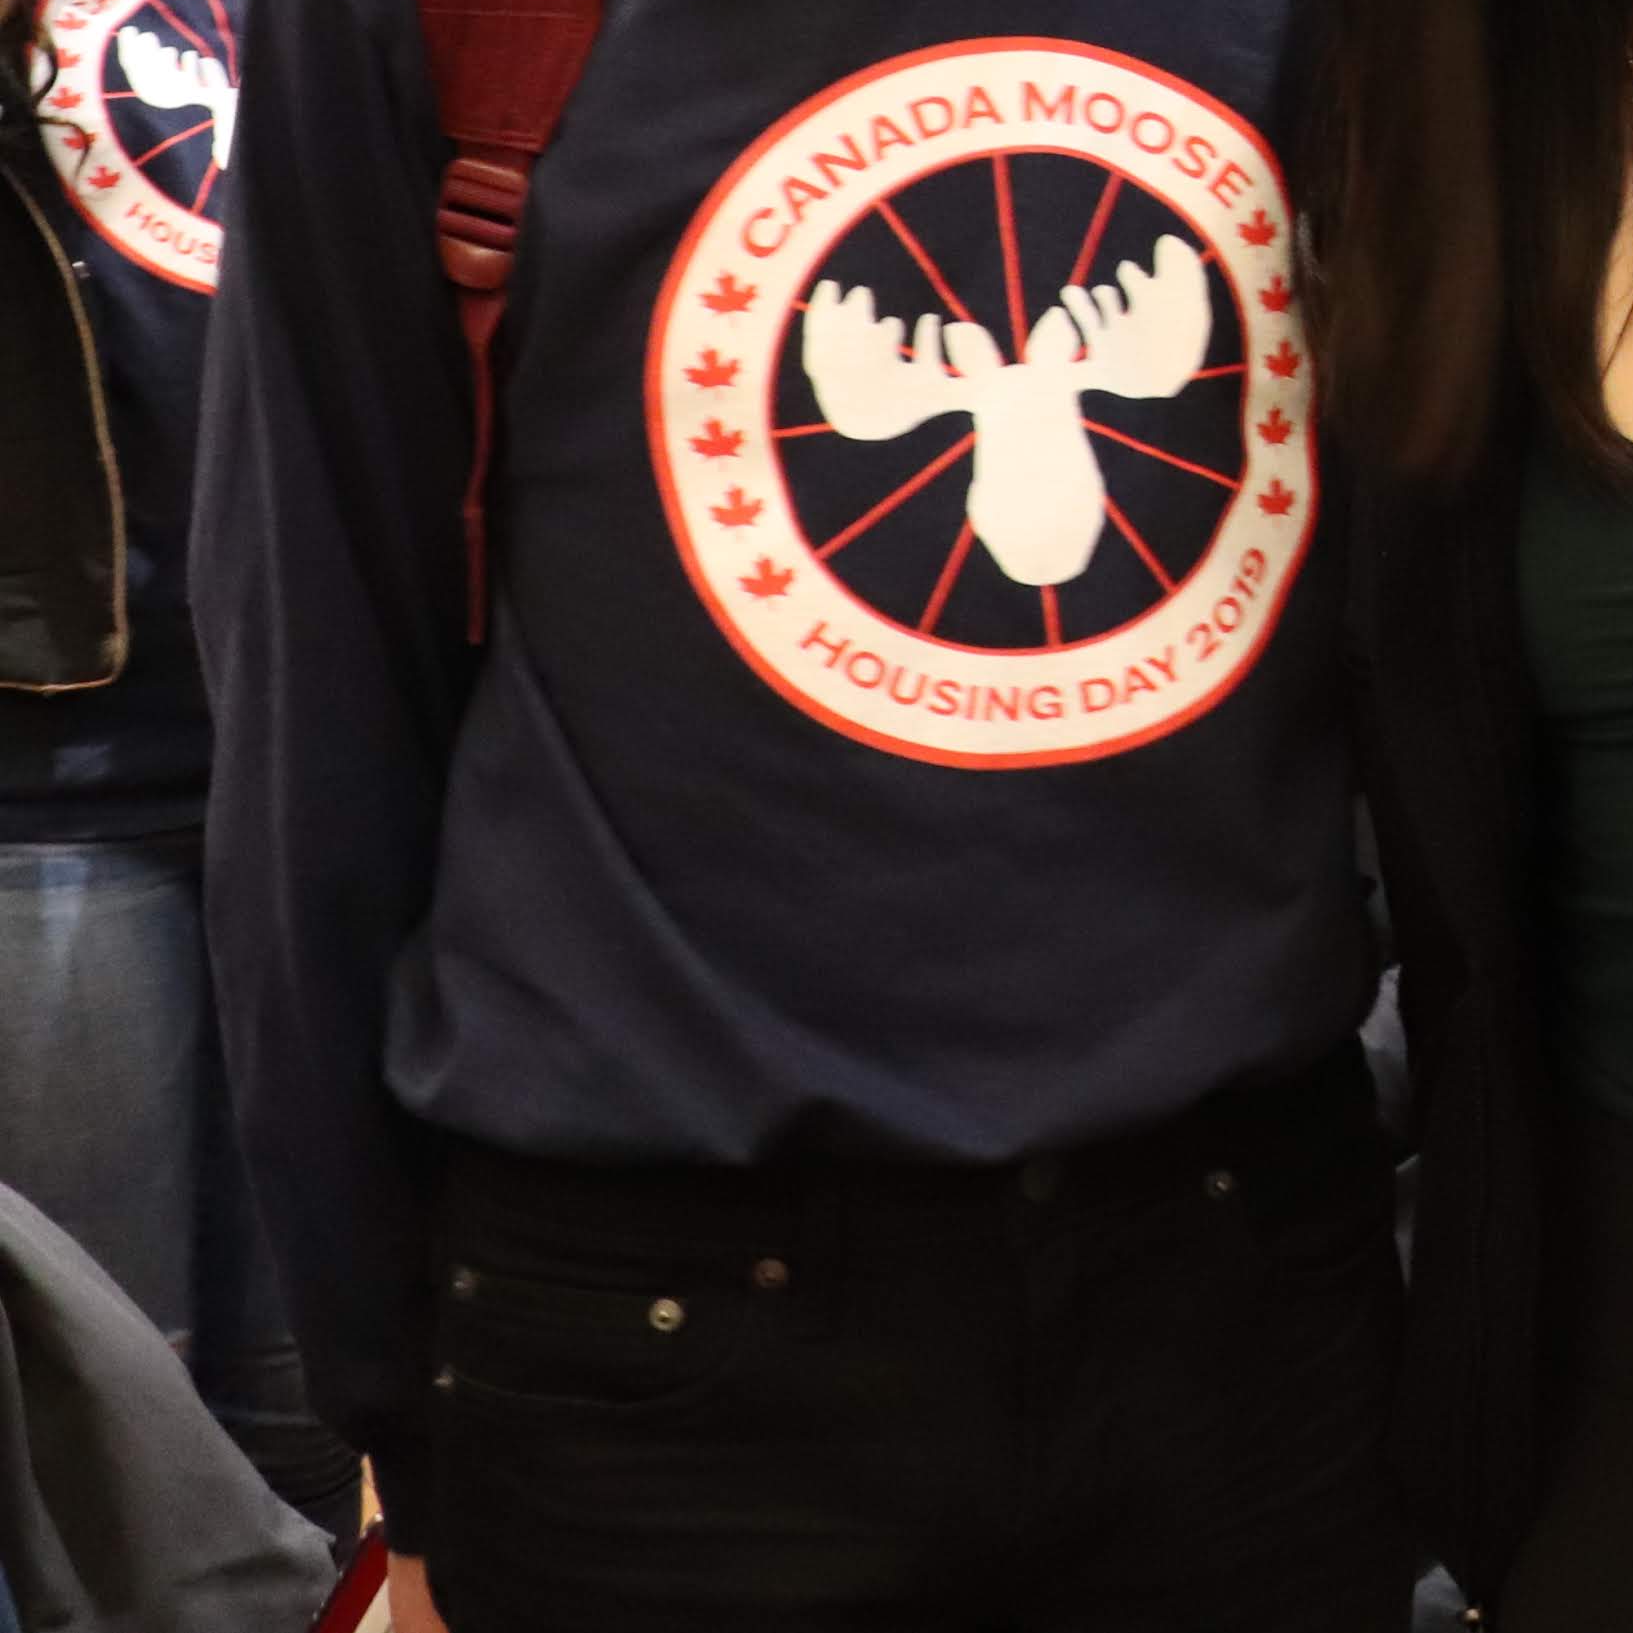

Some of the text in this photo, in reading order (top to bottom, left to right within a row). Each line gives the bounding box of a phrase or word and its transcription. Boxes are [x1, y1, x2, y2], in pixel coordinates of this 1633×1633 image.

[739, 81, 1254, 259] CANADA MOOSE
[800, 546, 1269, 721] HOUSING DAY 2019
